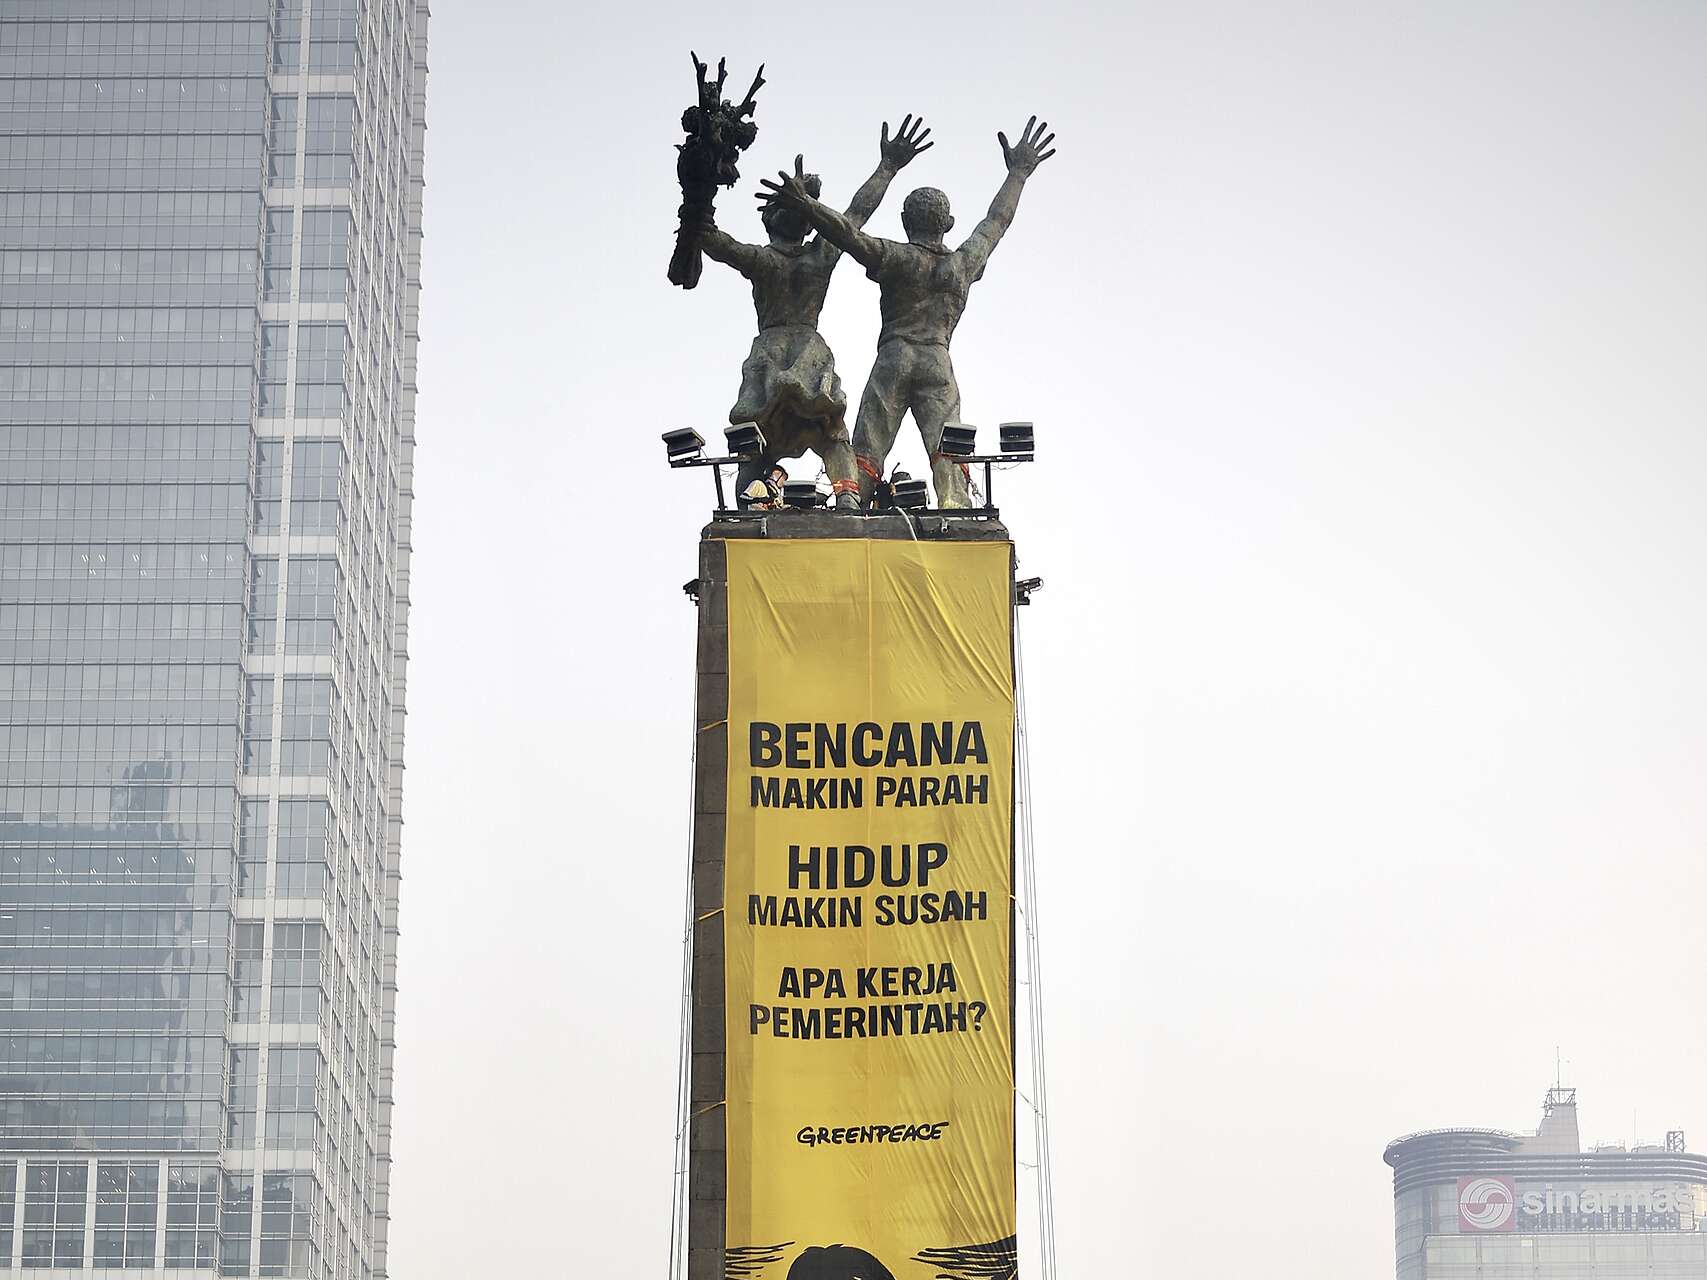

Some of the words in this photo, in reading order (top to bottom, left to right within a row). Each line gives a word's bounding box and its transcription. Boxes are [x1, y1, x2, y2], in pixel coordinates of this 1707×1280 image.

[749, 721, 989, 768] BENCANA
[750, 776, 863, 809] MAKIN
[875, 774, 989, 808] PARAH
[788, 842, 948, 890] HIDUP
[748, 894, 862, 928] MAKIN
[874, 890, 987, 926] SUSAH
[778, 966, 846, 998] APA
[857, 962, 957, 997] KERJA
[749, 1001, 987, 1040] PEMERINTAH?
[796, 1121, 950, 1148] GREENPEACE
[1522, 1183, 1696, 1215] sinarmas
